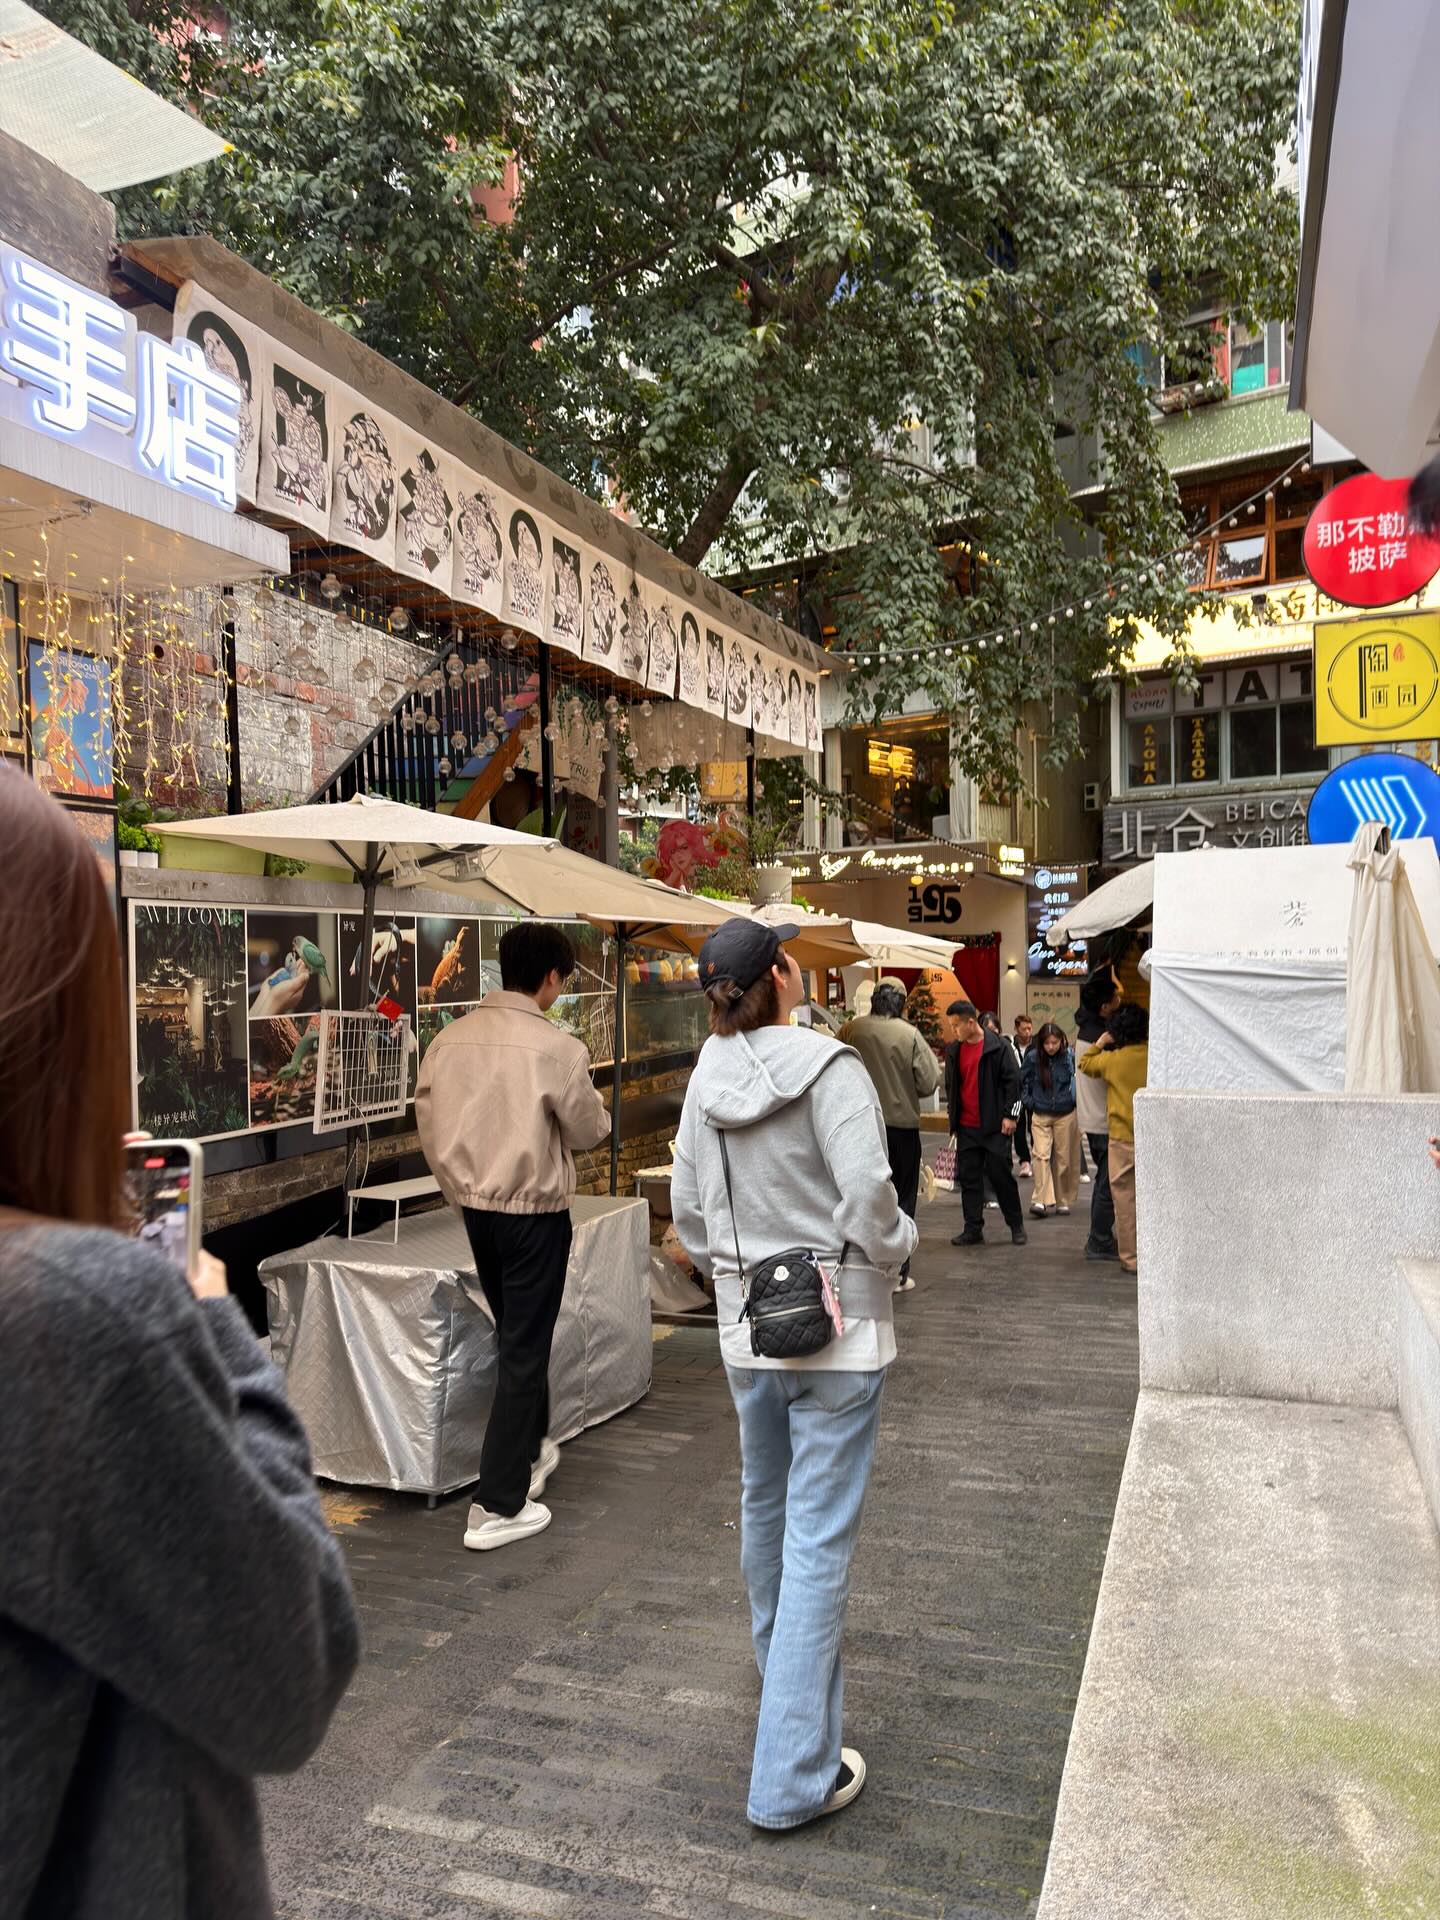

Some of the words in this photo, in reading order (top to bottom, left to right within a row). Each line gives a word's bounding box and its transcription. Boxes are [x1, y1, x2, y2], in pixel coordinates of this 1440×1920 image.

[1348, 541, 1408, 575] 披萨
[1143, 724, 1157, 785] ALOHA
[1191, 718, 1206, 780] TATTOO
[1109, 806, 1215, 861] 北仓
[1028, 941, 1056, 959] Our
[1047, 958, 1088, 976] cigars
